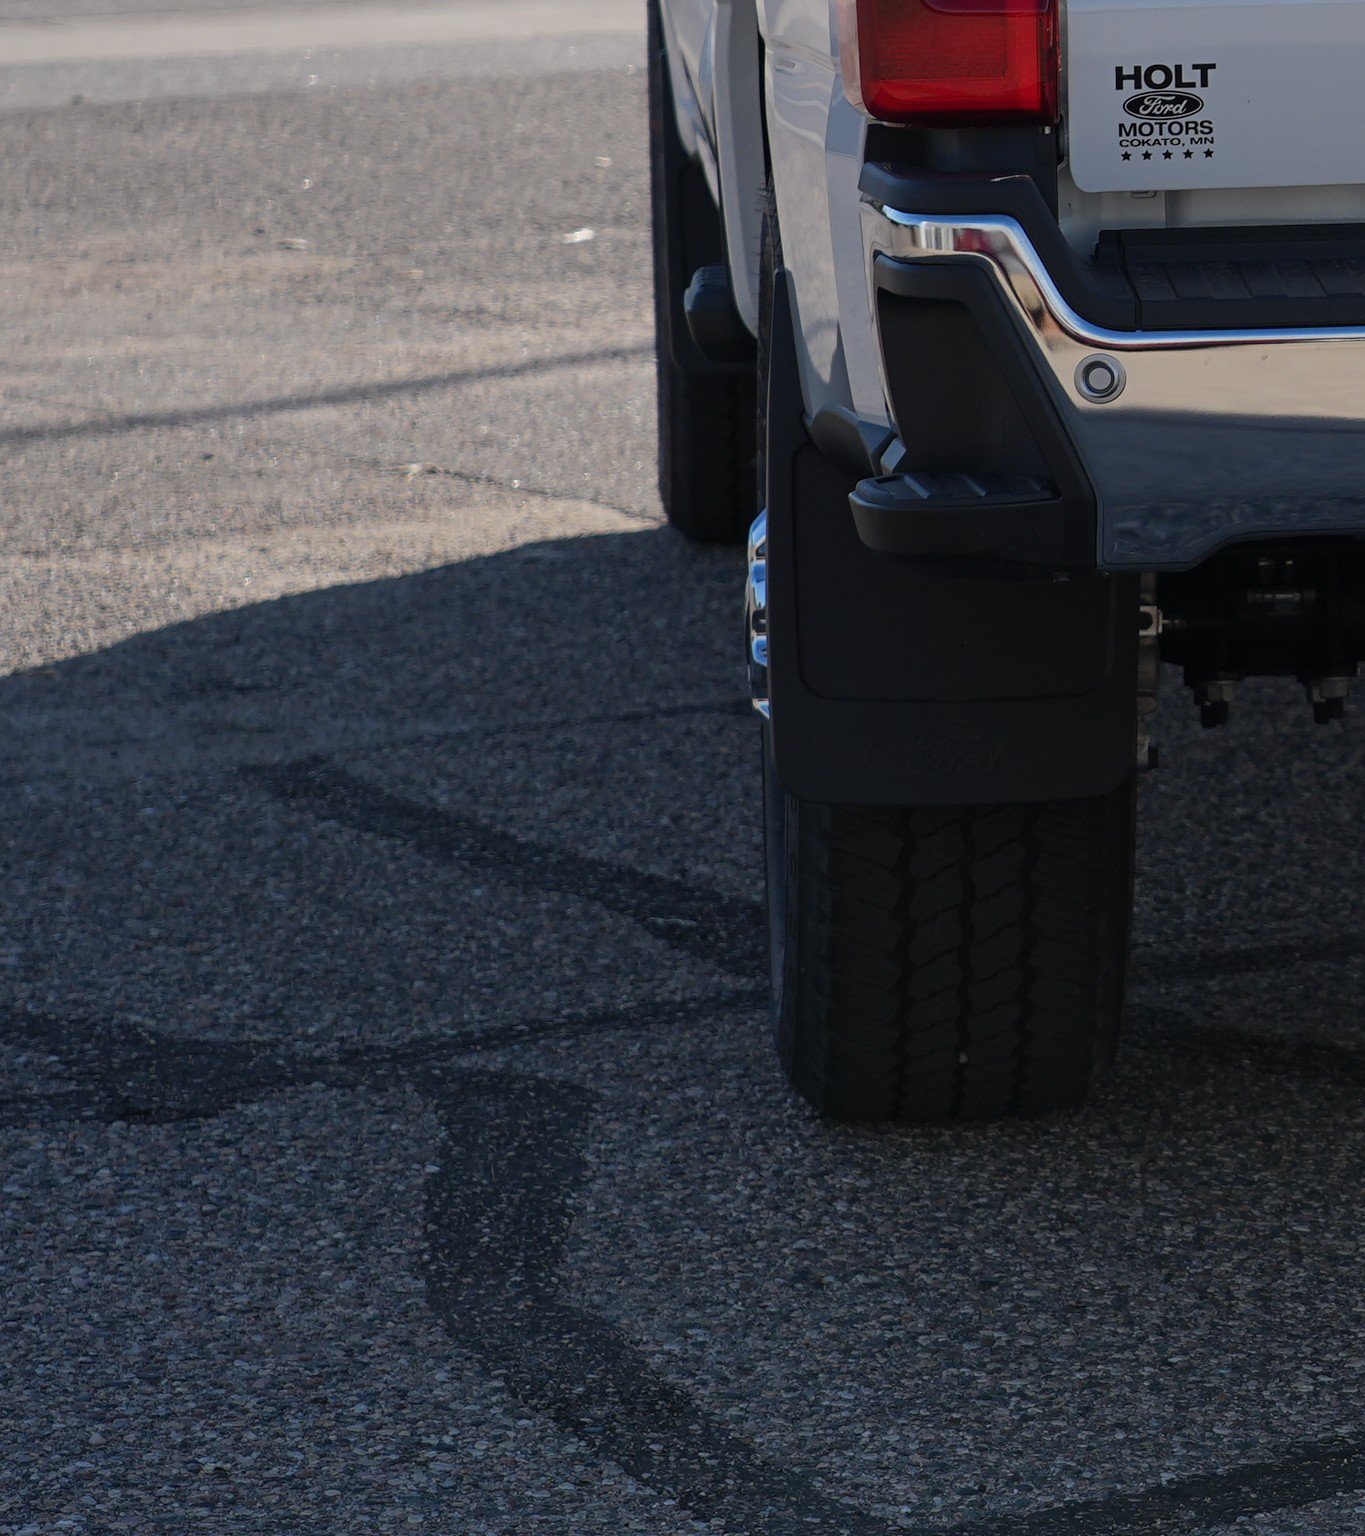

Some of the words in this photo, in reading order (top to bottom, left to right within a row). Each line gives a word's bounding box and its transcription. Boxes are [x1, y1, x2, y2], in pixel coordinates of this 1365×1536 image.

[1115, 63, 1216, 91] HOLT
[1138, 95, 1188, 115] Ford
[1118, 120, 1213, 137] MOTORS
[1119, 137, 1185, 148] COKATO,
[1190, 136, 1214, 145] MN
[904, 731, 1006, 777] Ford
